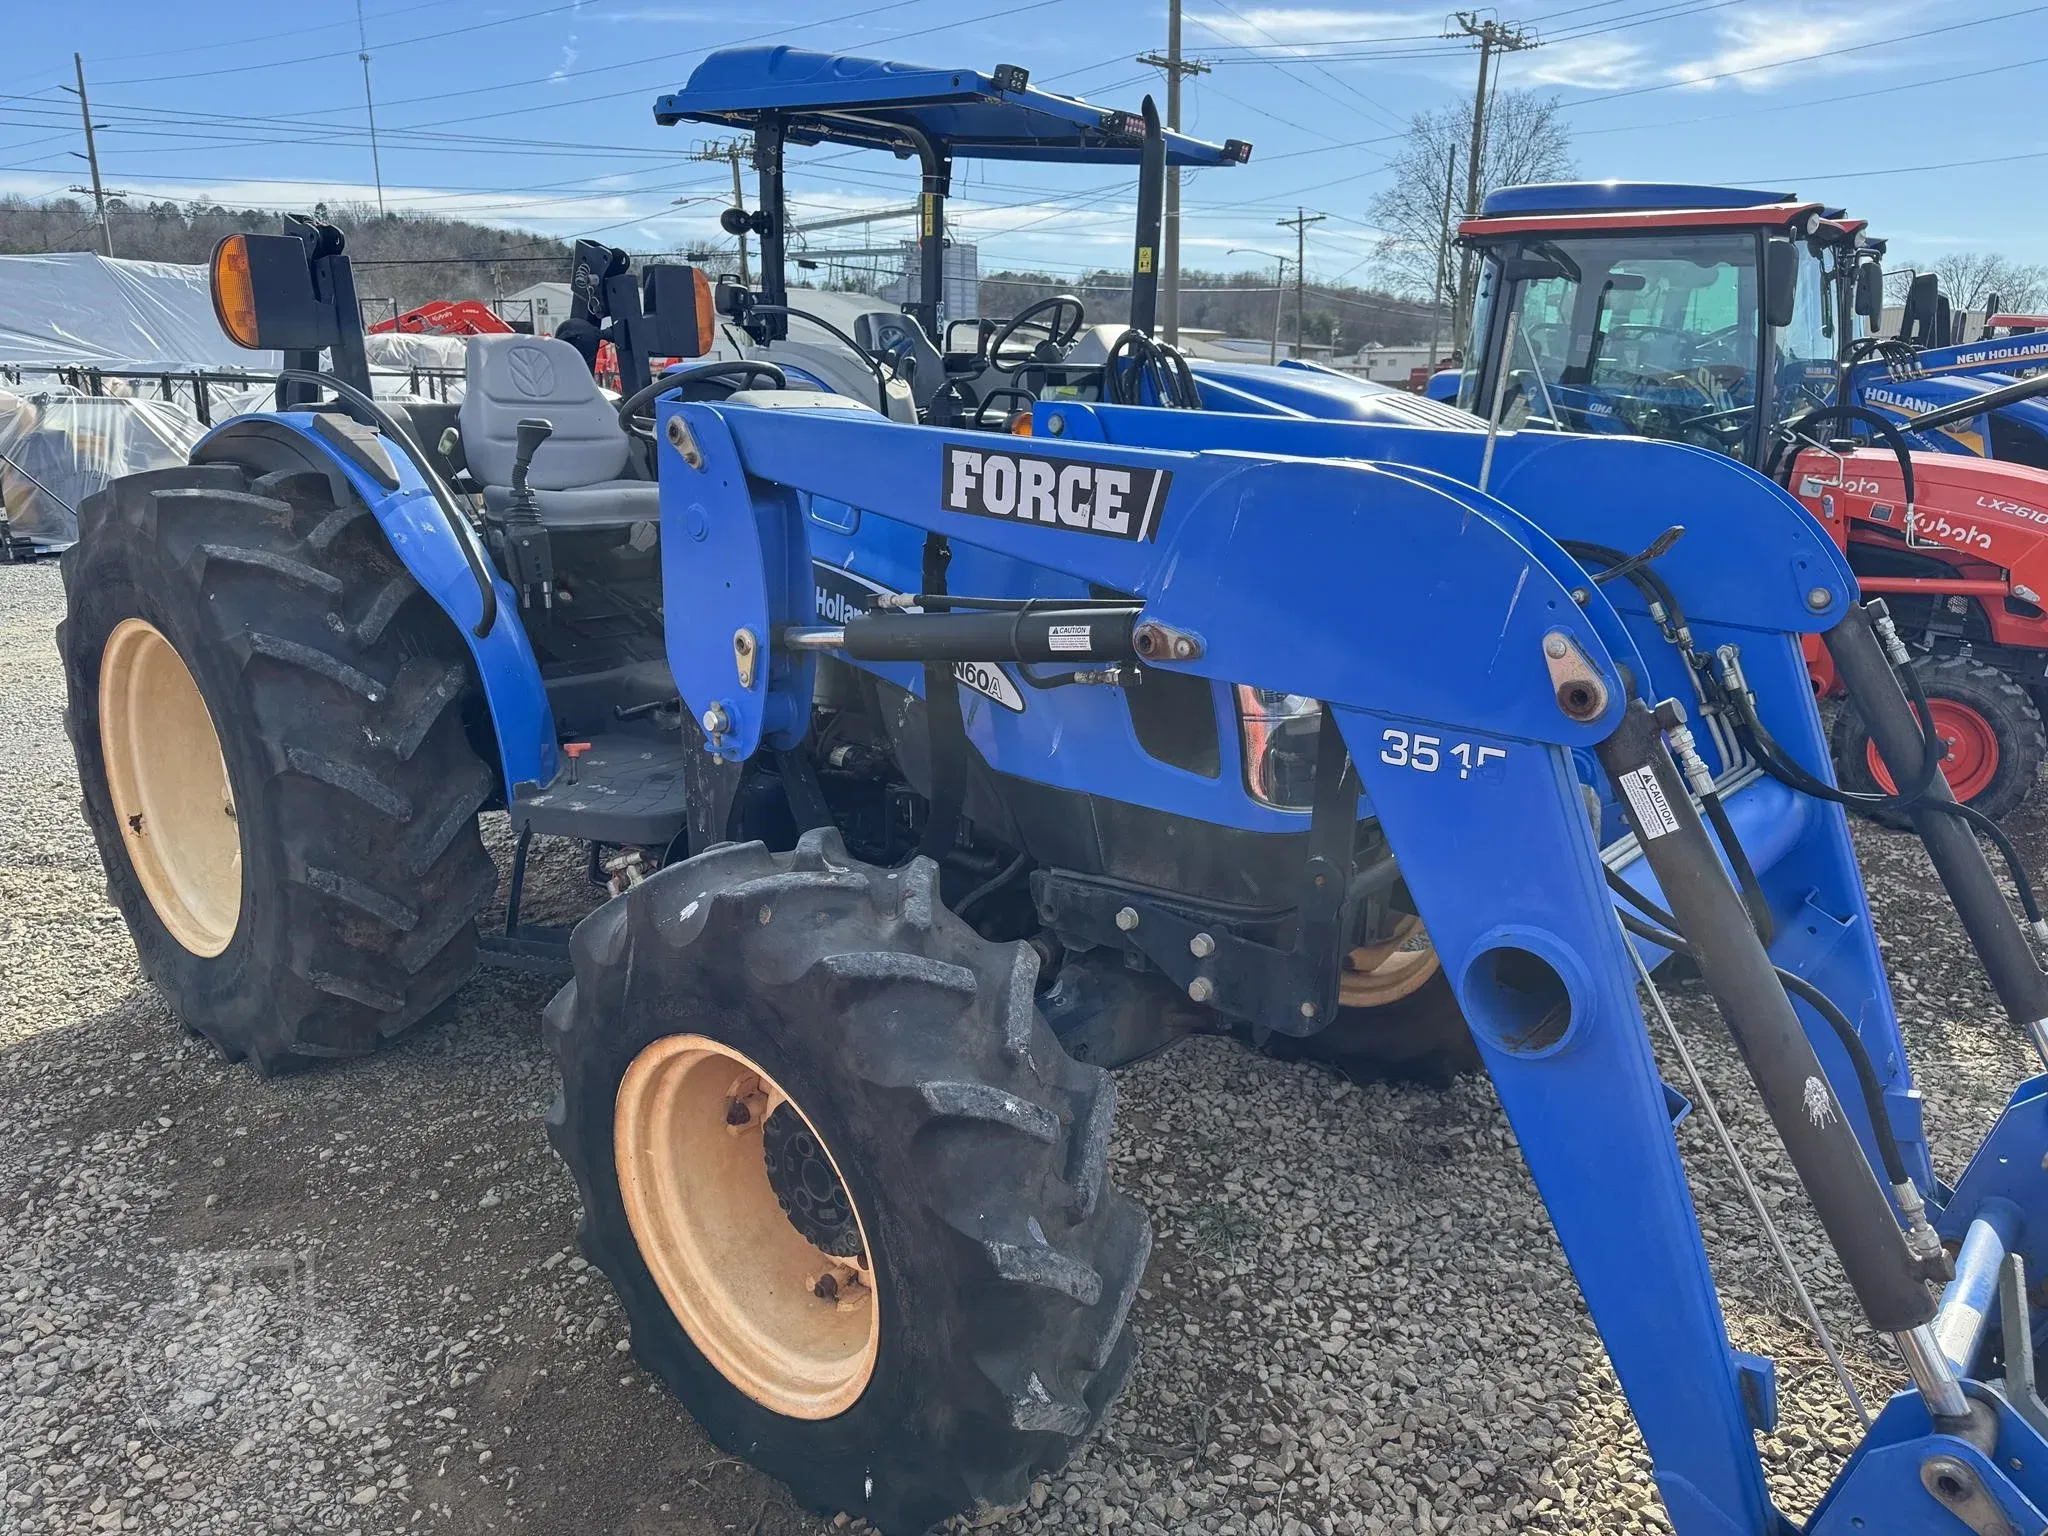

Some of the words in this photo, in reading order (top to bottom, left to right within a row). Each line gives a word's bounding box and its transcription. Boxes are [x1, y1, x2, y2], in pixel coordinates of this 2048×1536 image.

[1956, 351, 1986, 364] NEW
[1988, 343, 2048, 360] HOLLAND
[1864, 387, 1938, 413] HOLLAND
[950, 449, 1131, 534] FORCE
[1976, 496, 2048, 524] LX2610
[1903, 512, 1992, 549] Kubota
[815, 586, 872, 624] Holla
[1648, 783, 1674, 825] CAUTION
